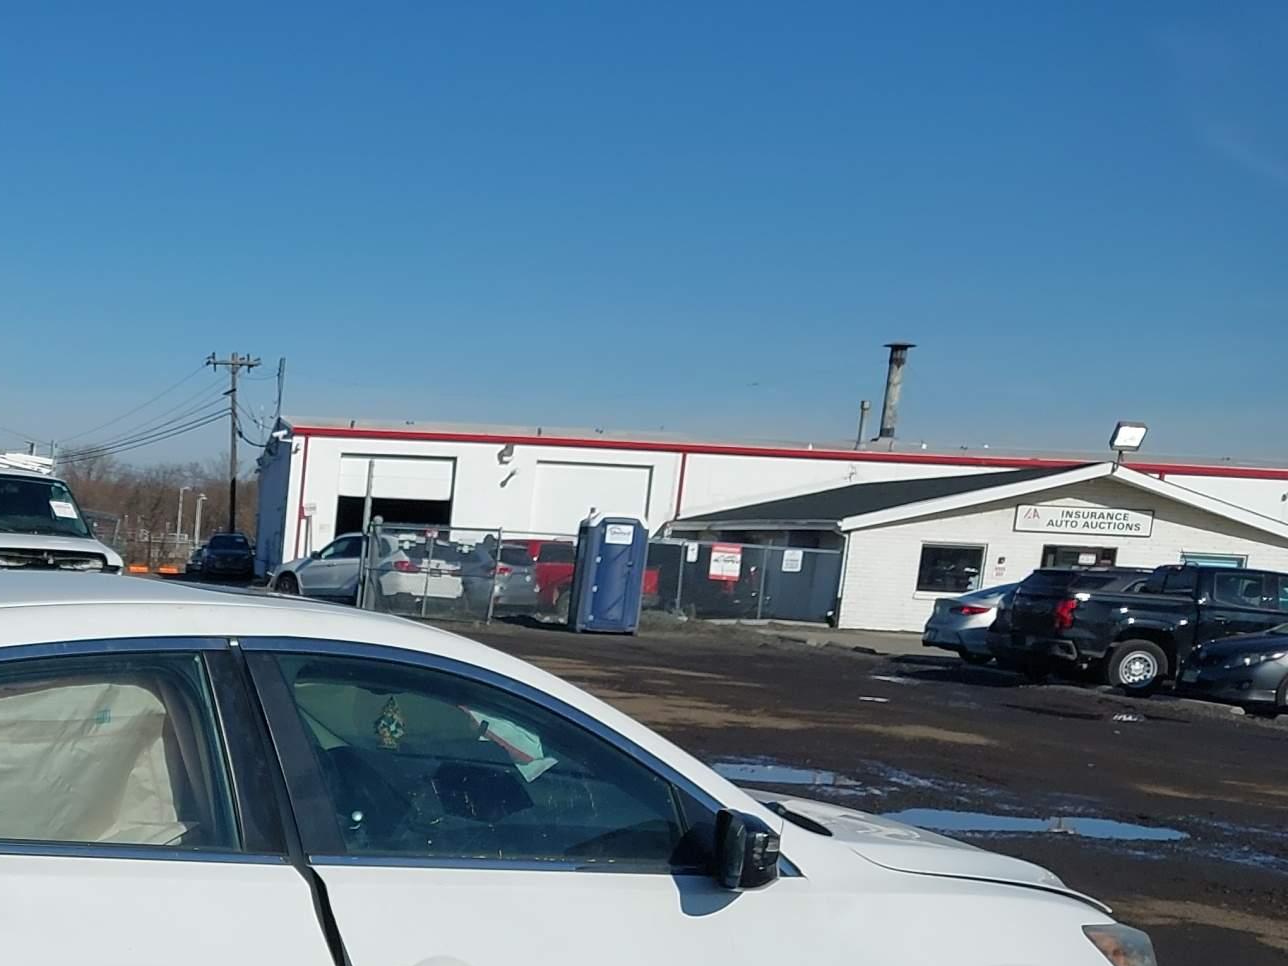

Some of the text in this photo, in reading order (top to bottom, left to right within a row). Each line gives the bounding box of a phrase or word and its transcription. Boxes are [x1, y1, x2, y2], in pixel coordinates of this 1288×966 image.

[1060, 510, 1130, 522] INSURANCE
[1046, 519, 1142, 532] AUTO AUCTIONS
